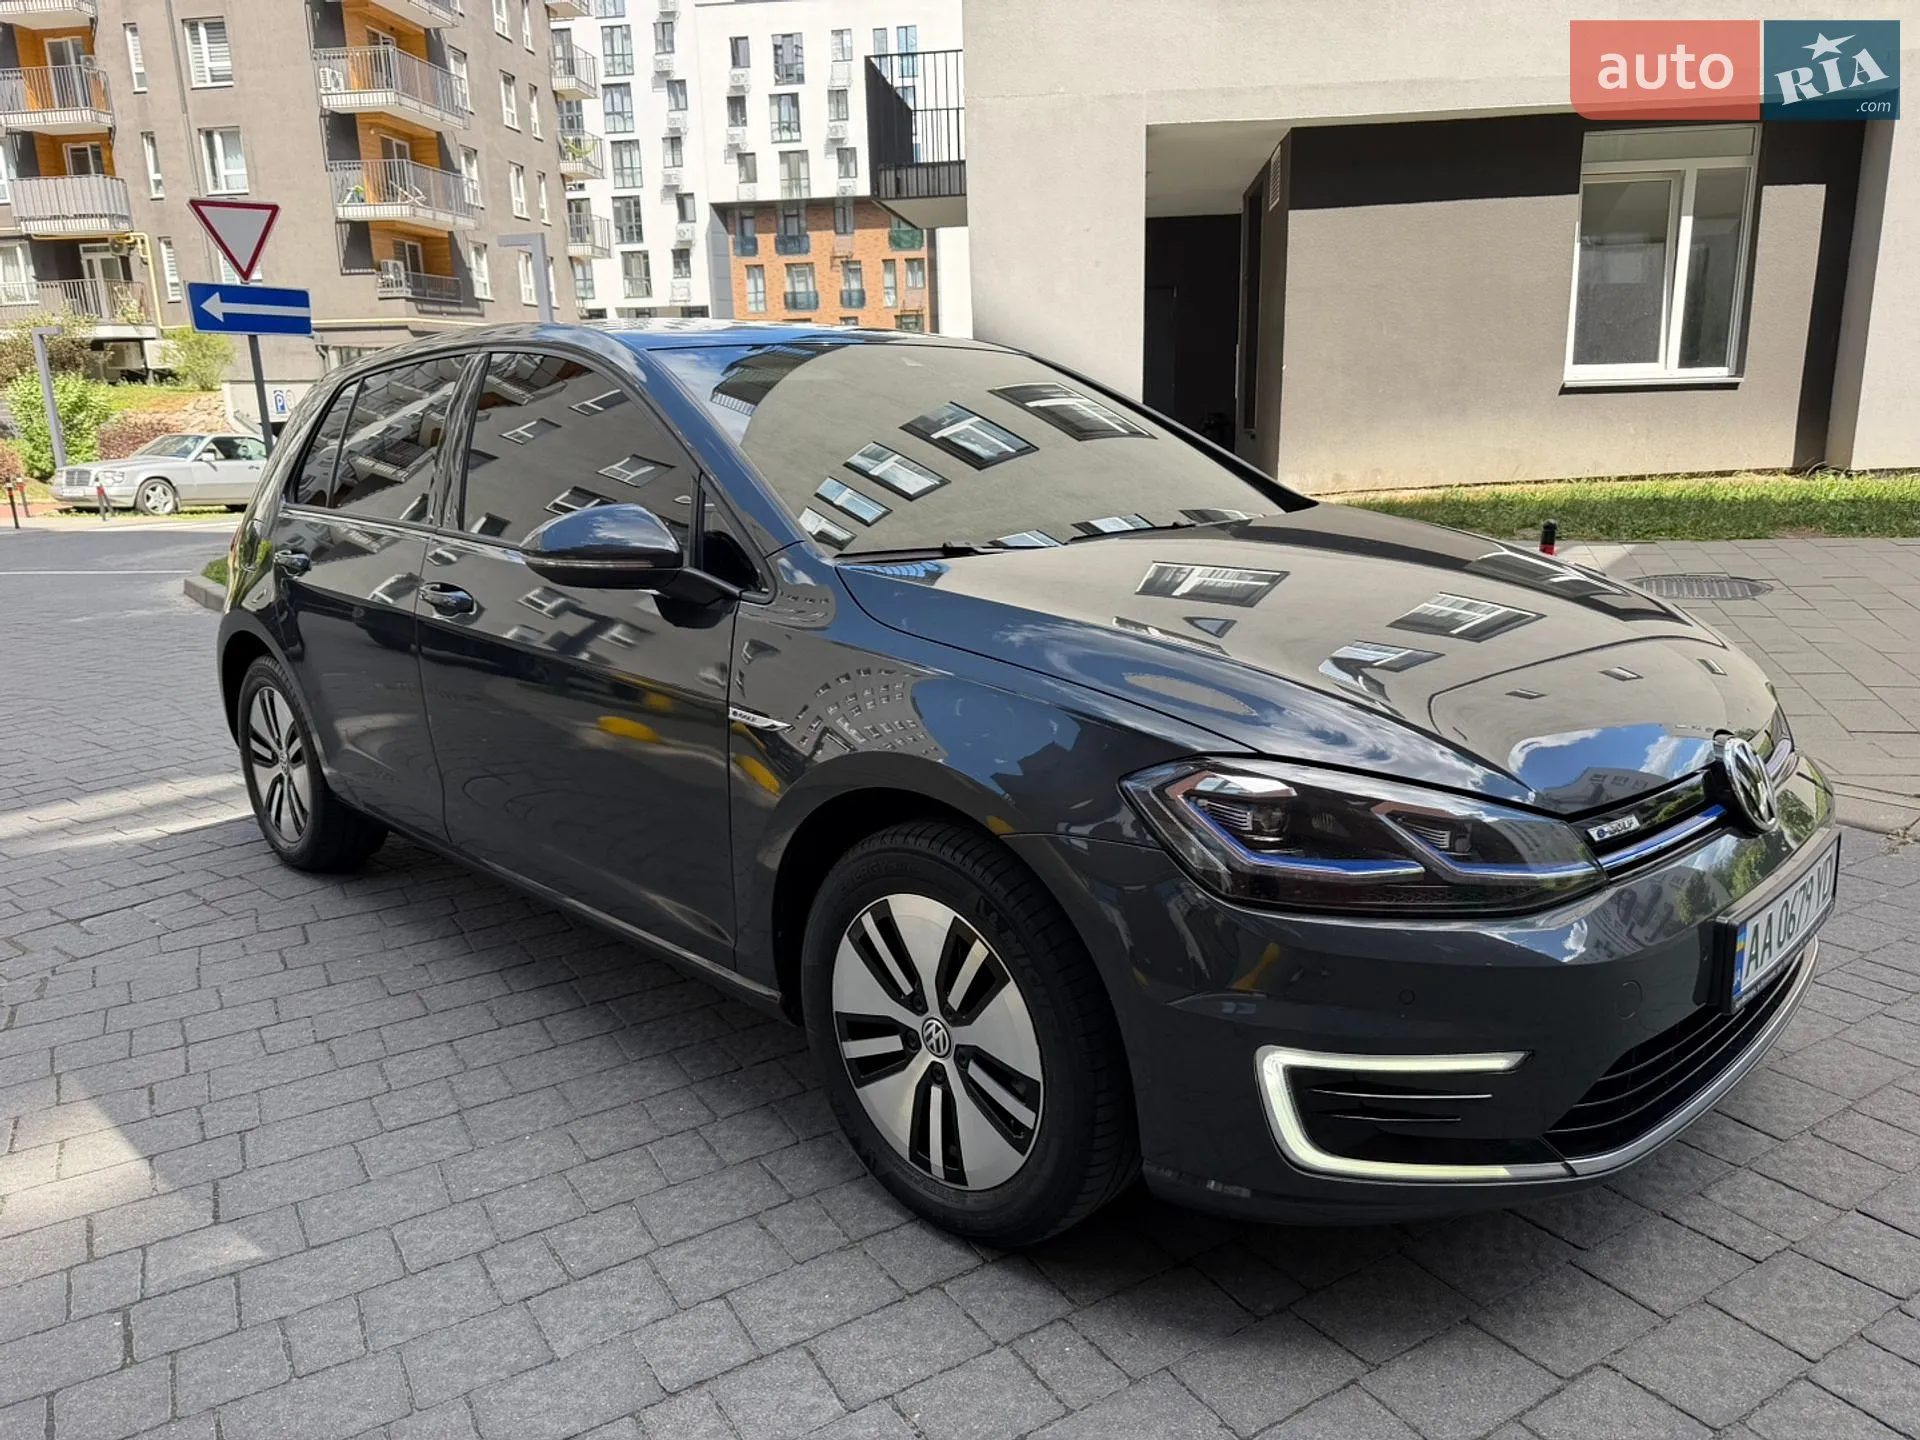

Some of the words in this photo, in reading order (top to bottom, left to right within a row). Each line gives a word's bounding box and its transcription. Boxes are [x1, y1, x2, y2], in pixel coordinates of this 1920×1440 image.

[1744, 912, 1773, 979] AA
[1777, 875, 1814, 948] 0679
[1816, 853, 1833, 908] YD
